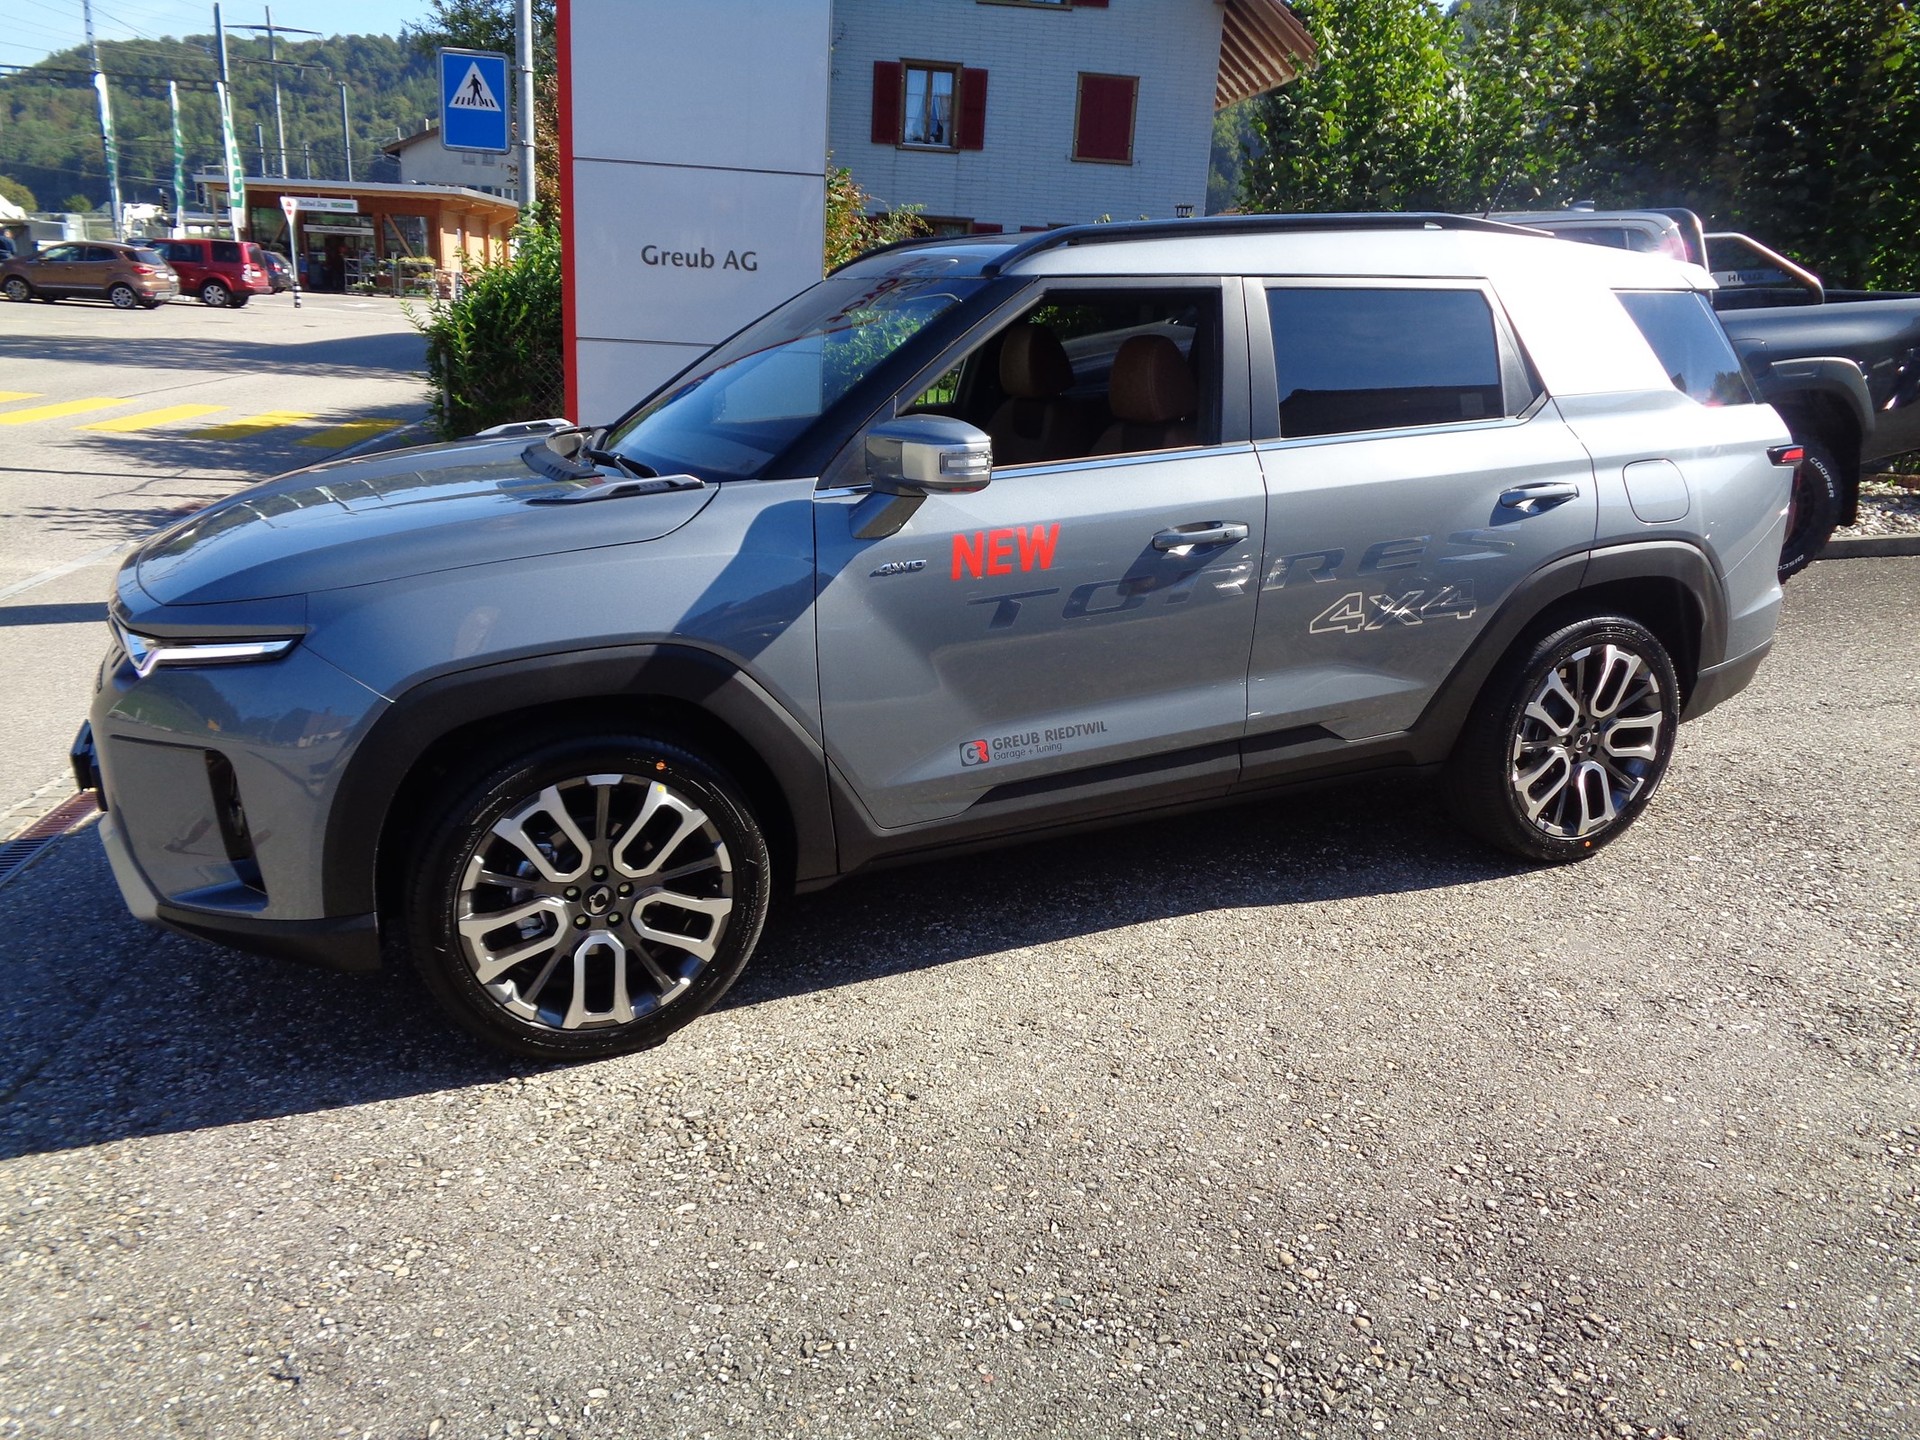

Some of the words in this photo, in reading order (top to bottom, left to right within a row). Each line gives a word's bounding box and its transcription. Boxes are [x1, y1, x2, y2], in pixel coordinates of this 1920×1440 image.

[641, 244, 715, 269] Greub
[722, 250, 758, 272] AG
[1810, 457, 1835, 498] COOPER
[951, 522, 1062, 582] NEW
[869, 559, 927, 578] 4WD
[992, 731, 1041, 751] GREUB
[1044, 720, 1108, 742] RIEDTWIL
[993, 748, 1026, 761] Garage
[1036, 742, 1063, 753] Tuning
